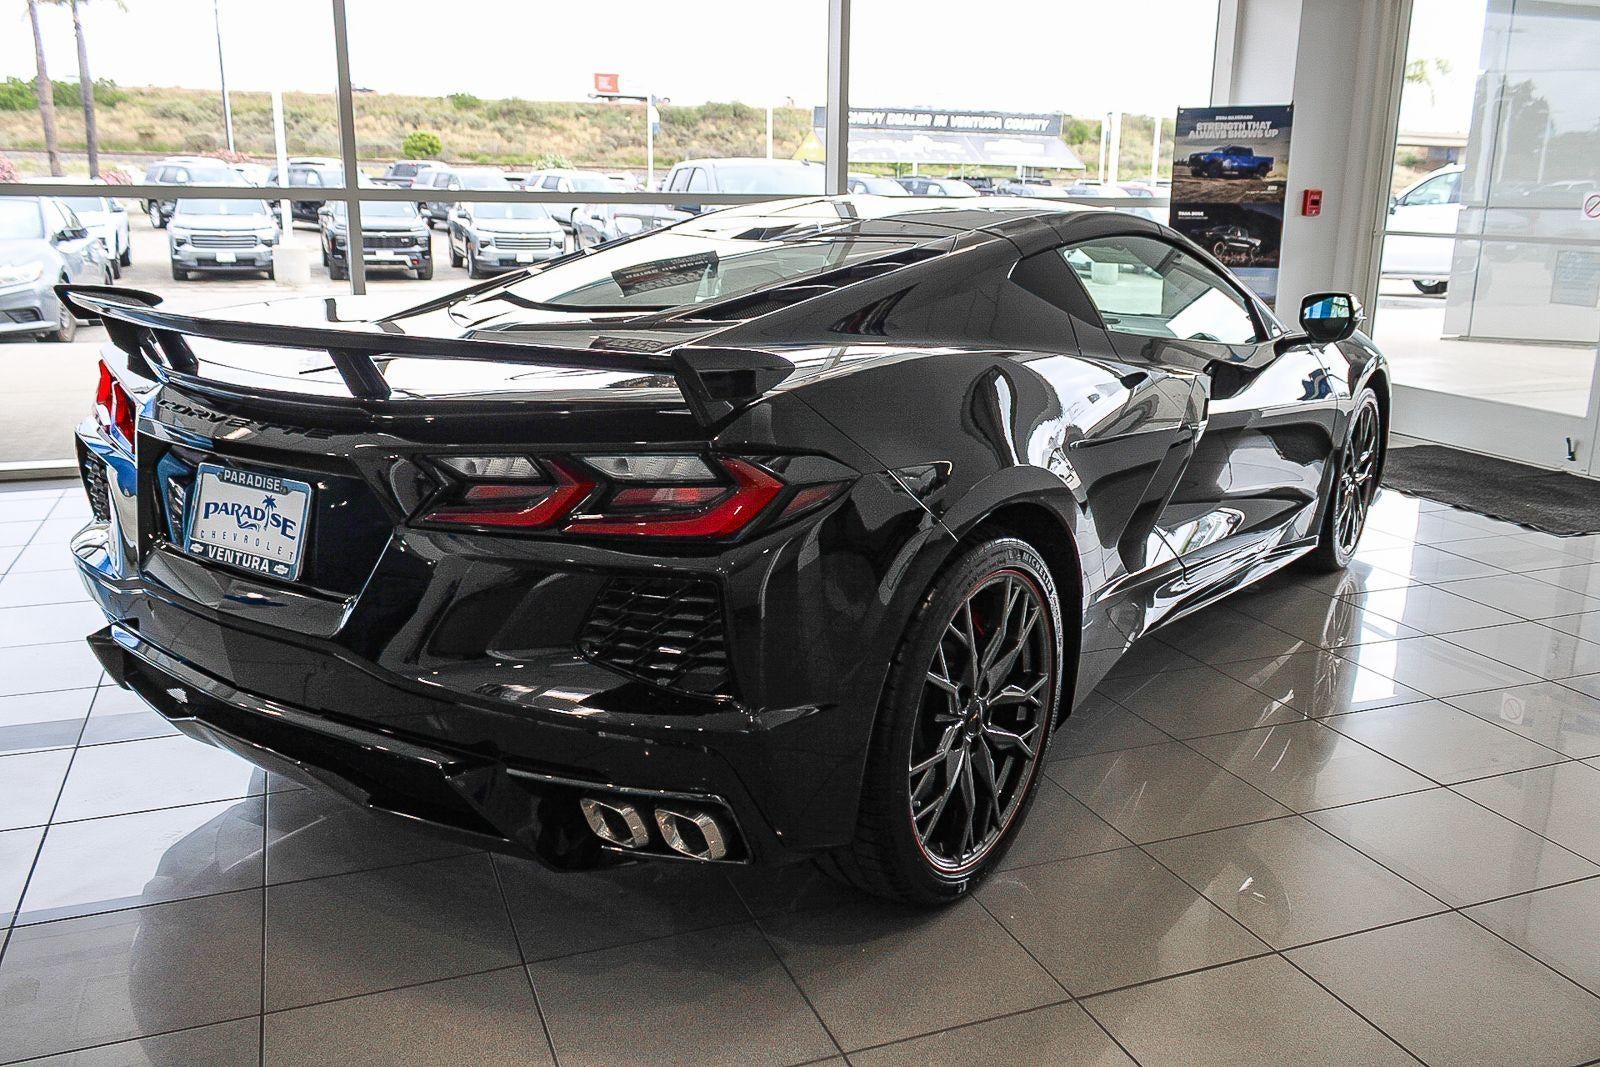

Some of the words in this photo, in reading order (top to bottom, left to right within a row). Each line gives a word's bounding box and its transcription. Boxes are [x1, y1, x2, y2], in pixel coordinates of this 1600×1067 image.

[886, 112, 932, 127] DEALER
[934, 113, 949, 128] IN
[950, 114, 1003, 129] VENTURA
[1004, 116, 1051, 131] COUNTY
[1196, 121, 1246, 130] STRENGTH
[1247, 121, 1272, 129] THAT
[1188, 129, 1227, 139] ALWAYS
[1228, 129, 1264, 138] SHOWS
[1264, 128, 1279, 138] UP
[223, 469, 281, 492] PARADISE
[203, 495, 296, 541] PARADISE
[200, 529, 294, 561] CHEVROLET
[208, 545, 270, 573] VENTURA
